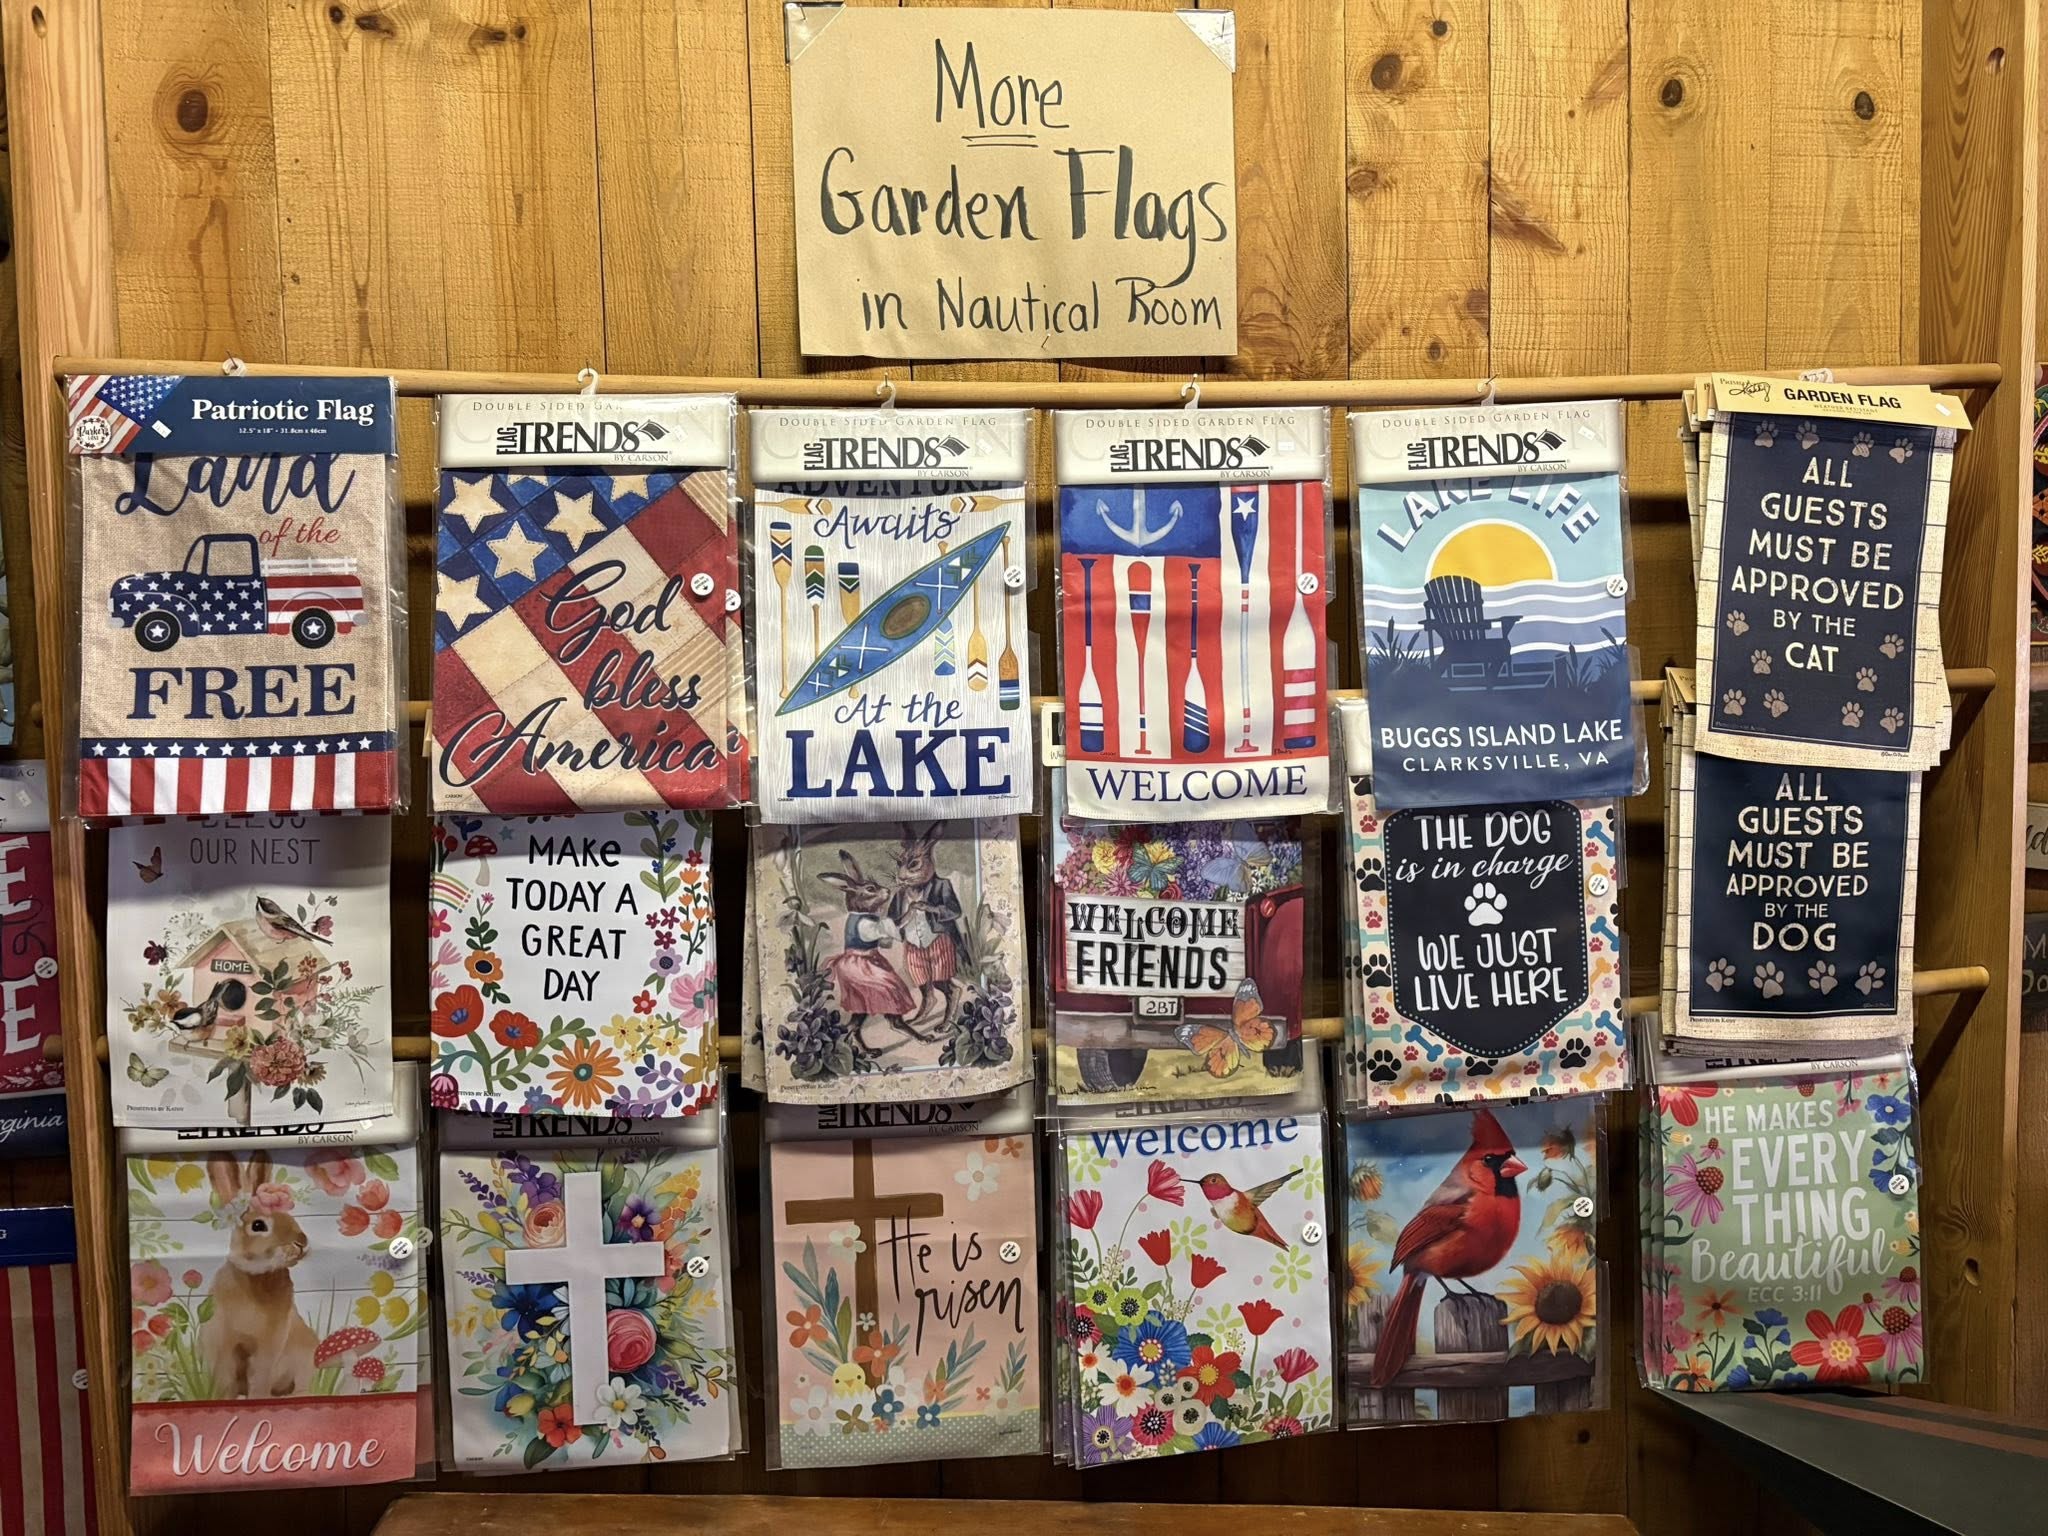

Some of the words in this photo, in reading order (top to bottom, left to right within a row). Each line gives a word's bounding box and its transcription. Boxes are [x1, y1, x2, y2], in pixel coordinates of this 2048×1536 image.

[936, 38, 1069, 128] More
[820, 147, 1041, 240] Garden
[1053, 145, 1227, 288] Flags
[856, 279, 907, 330] in
[937, 276, 1099, 333] Nautical
[1116, 277, 1222, 330] Room
[192, 398, 309, 421] Patriotic
[316, 398, 375, 426] Flag
[1784, 387, 1855, 405] GARDEN
[1859, 392, 1902, 410] FLAG
[496, 427, 517, 454] FLAG
[513, 421, 640, 453] TRENDS
[804, 443, 824, 470] FLAG
[819, 437, 940, 468] TRENDS
[1110, 444, 1129, 472] FLAG
[1124, 438, 1242, 471] TRENDS
[1407, 442, 1427, 470] FLAG
[1421, 432, 1539, 468] TRENDS
[628, 453, 668, 461] CARSON
[1220, 470, 1230, 478] BY
[1233, 470, 1270, 478] CARSON
[1530, 463, 1567, 472] CARSON
[1802, 456, 1854, 488] ALL
[115, 453, 356, 516] Land
[813, 499, 961, 550] Awaits
[1377, 475, 1492, 552] LAKE
[1508, 475, 1600, 544] LIFE
[1760, 493, 1888, 530] GUESTS
[260, 517, 293, 557] of
[295, 518, 341, 545] the
[1749, 528, 1836, 565] MUST
[1850, 541, 1893, 571] BE
[1731, 565, 1904, 610] APPROVED
[540, 560, 682, 666] God
[1773, 610, 1801, 629] BY
[1812, 614, 1856, 637] THE
[1785, 642, 1839, 673] CAT
[126, 663, 356, 720] FREE
[584, 649, 702, 710] bless
[835, 693, 892, 725] At
[901, 691, 963, 728] the
[438, 697, 722, 788] America
[1381, 727, 1462, 749] BUGGS
[1468, 723, 1556, 747] ISLAND
[1563, 719, 1623, 743] LAKE
[786, 727, 1011, 799] LAKE
[1403, 753, 1569, 773] CLARKSVILLE,
[1579, 752, 1609, 766] VA
[1086, 765, 1308, 802] WELCOME
[1775, 772, 1829, 801] ALL
[1414, 814, 1473, 851] THE
[1485, 809, 1551, 848] DOG
[1737, 805, 1863, 836] GUESTS
[190, 838, 239, 865] OUR
[250, 838, 320, 865] NEST
[1396, 858, 1425, 883] is
[1432, 856, 1466, 880] in
[1472, 847, 1574, 889] charge
[1727, 840, 1814, 869] MUST
[1832, 841, 1869, 869] BE
[506, 878, 606, 913] TODAY
[615, 883, 639, 915] A
[1726, 873, 1869, 898] APPROVED
[1068, 901, 1241, 944] WELCOME
[1764, 903, 1787, 918] BY
[1794, 903, 1829, 918] THE
[522, 924, 627, 960] GREAT
[1418, 934, 1466, 972] WE
[1476, 927, 1557, 968] JUST
[1753, 922, 1836, 952] DOG
[213, 959, 252, 974] HOME
[1076, 940, 1228, 990] FRIENDS
[543, 968, 600, 1002] DAY
[1414, 972, 1480, 1011] LIVE
[1490, 966, 1568, 1007] HERE
[1146, 1000, 1177, 1016] 2BT
[1811, 1062, 1821, 1070] BY
[1823, 1060, 1858, 1069] CARSON
[928, 1125, 938, 1133] BY
[941, 1124, 978, 1132] CARSON
[1704, 1105, 1737, 1134] HE
[1747, 1099, 1834, 1132] MAKES
[298, 1136, 310, 1144] BY
[311, 1134, 354, 1144] CARSON
[1090, 1116, 1298, 1159] Welcome
[1732, 1129, 1866, 1191] EVERY
[1732, 1186, 1870, 1246] THING
[878, 1206, 932, 1304] He
[949, 1220, 983, 1273] is
[1691, 1227, 1895, 1295] Beautiful
[1748, 1286, 1785, 1303] ECC
[1791, 1286, 1822, 1302] 3:11
[914, 1276, 1025, 1357] risen
[154, 1415, 386, 1477] Welcome
